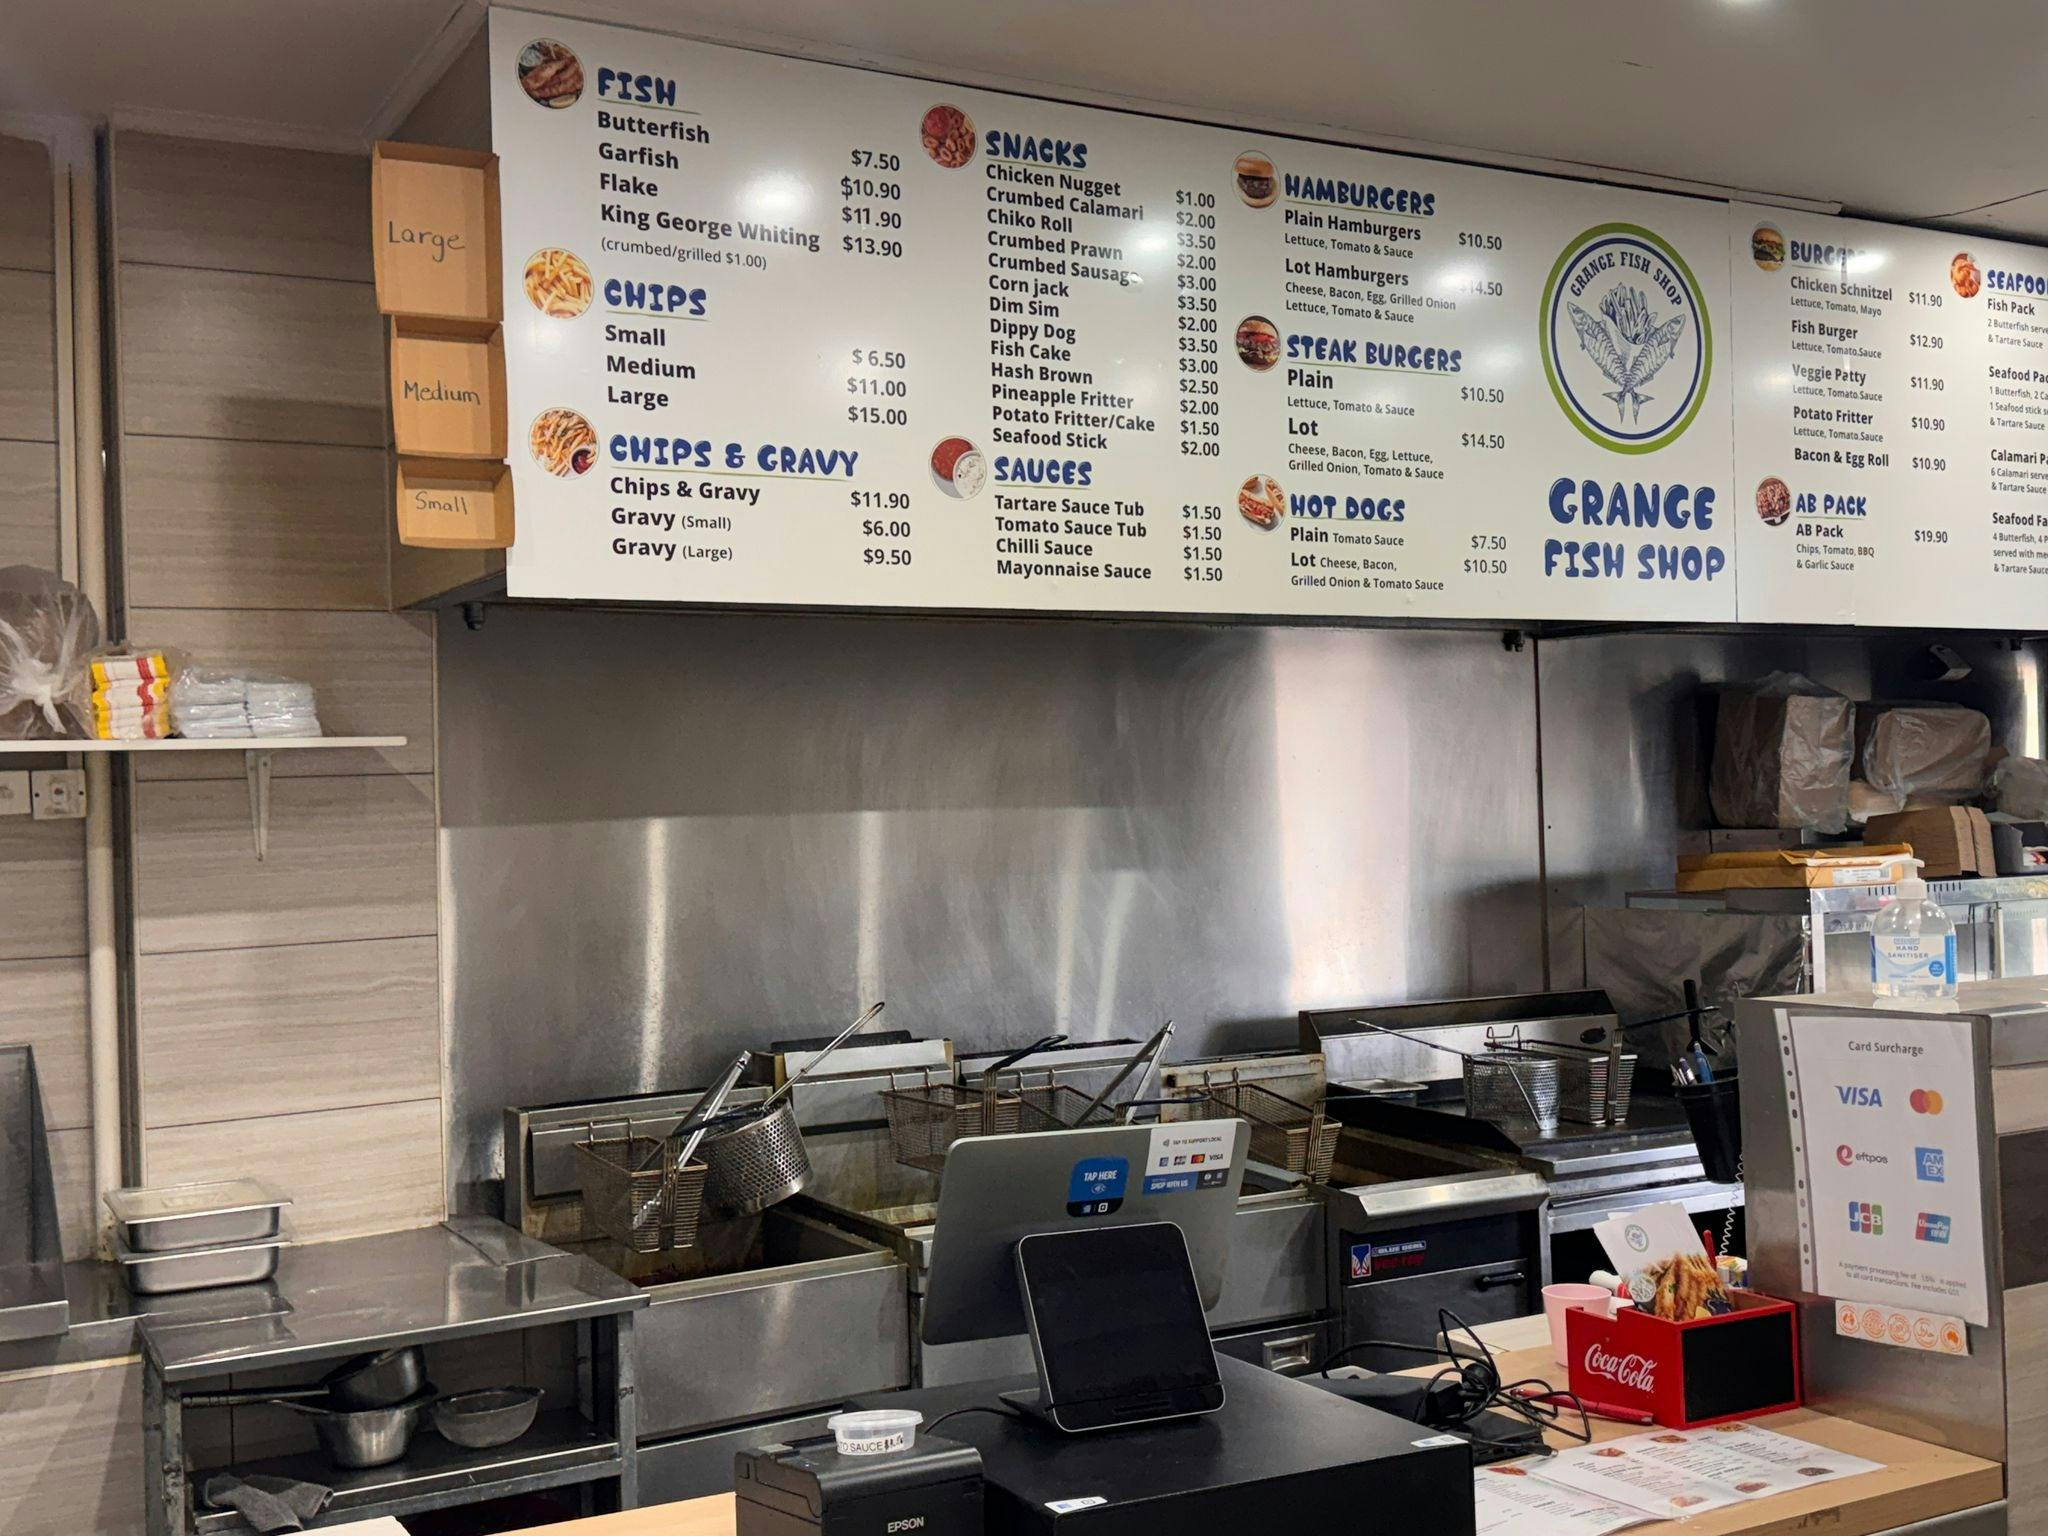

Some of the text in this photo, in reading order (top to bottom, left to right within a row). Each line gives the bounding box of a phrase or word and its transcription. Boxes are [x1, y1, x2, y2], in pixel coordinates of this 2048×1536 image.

[598, 68, 675, 107] FISH
[598, 111, 709, 143] Butterfish
[599, 143, 678, 169] Garfish
[852, 150, 899, 171] $7.50
[986, 131, 1087, 170] SNACKS
[601, 173, 657, 196] Flake
[841, 176, 900, 200] $10.90
[986, 164, 1120, 198] Chicken Nugget
[987, 187, 1143, 220] Crumbed Calamari
[1176, 190, 1214, 208] $1.00
[1285, 174, 1434, 216] HAMBURGERS
[602, 204, 820, 252] King George Whiting
[842, 207, 901, 228] $11.90
[988, 209, 1072, 232] Chiko Roll
[1286, 210, 1420, 241] Plain Hamburgers
[388, 220, 465, 262] Large
[844, 236, 902, 257] $13.90
[988, 231, 1122, 260] Crumbed Prawn
[1285, 233, 1413, 258] Lettuce, Tomato & Sauce
[1459, 232, 1502, 250] $10.50
[602, 238, 766, 270] (crumbed/grilled $1.00)
[989, 253, 1065, 275] Crumbed
[1178, 275, 1216, 291] $3.00
[1286, 258, 1408, 287] Lot Hamburgers
[1571, 252, 1682, 307] GRANGE FISH SHOP
[1988, 270, 2048, 295] SEAFOO
[604, 279, 706, 315] CHIPS
[990, 275, 1068, 298] Corn jack
[1791, 276, 1892, 300] Chicken Schnitzel
[990, 297, 1058, 317] Dim Sim
[1791, 296, 1881, 317] Lettuce, Tomato, Mayo
[1909, 292, 1942, 307] $11.90
[1988, 298, 2034, 315] Fish Pack
[991, 319, 1075, 344] Dippy Dog
[1179, 316, 1216, 332] $2.00
[1792, 320, 1858, 341] Fish Burger
[606, 325, 665, 346] Small
[1179, 337, 1217, 353] $3.50
[1910, 334, 1943, 349] $12.90
[992, 340, 1070, 361] Fish Cake
[1287, 335, 1461, 372] STEAK BURGERS
[608, 356, 695, 379] Medium
[992, 362, 1092, 384] Hash Brown
[1792, 364, 1866, 386] Veggie Patty
[848, 378, 906, 397] $11.00
[1288, 369, 1332, 388] Plain
[1911, 377, 1944, 391] $11.90
[404, 380, 480, 405] Medium
[608, 386, 668, 410] Large
[992, 384, 1133, 408] Pineapple Fritter
[1462, 387, 1504, 402] $10.50
[849, 406, 906, 425] $15.00
[993, 406, 1154, 431] Potato Fritter/Cake
[1794, 406, 1873, 424] Potato Fritter
[1912, 417, 1944, 431] $10.90
[1181, 420, 1219, 436] $1.50
[1289, 418, 1318, 436] Lot
[994, 428, 1106, 448] Seafood Stick
[1462, 433, 1504, 449] $14.50
[610, 435, 858, 476] CHIPS & GRAVY
[1795, 448, 1888, 468] Bacon & Egg Roll
[1913, 458, 1945, 470] $10.90
[994, 456, 1092, 485] SAUCES
[611, 477, 760, 506] Chips & Gravy
[851, 491, 909, 509] $11.90
[415, 491, 467, 515] Small
[995, 495, 1144, 516] Tartare Sauce Tub
[1183, 505, 1220, 520] $1.50
[1291, 494, 1405, 521] HOT DOGS
[1549, 478, 1716, 530] GRANGE
[1796, 494, 1866, 516] AB PACK
[612, 508, 730, 531] Gravy (Small)
[863, 520, 910, 537] $6.00
[995, 517, 1146, 537] Tomato Sauce Tub
[1291, 527, 1328, 542] Plain
[1796, 524, 1843, 537] AB Pack
[1915, 530, 1948, 543] $19.90
[613, 538, 732, 562] Gravy (Large)
[997, 538, 1092, 556] Chilli Sauce
[1472, 536, 1506, 550] $7.50
[864, 548, 911, 565] $9.50
[1292, 553, 1315, 566] Lot
[1464, 559, 1506, 574] $10.50
[1544, 538, 1725, 581] FISH SHOP
[998, 560, 1151, 579] Mayonnaise Sauce
[1849, 1041, 1924, 1057] Card Surcharge
[1834, 1085, 1882, 1107] VISA
[1084, 1170, 1118, 1181] TAP HERE
[850, 1442, 882, 1451] SAUCE
[888, 1517, 924, 1533] EPSON
